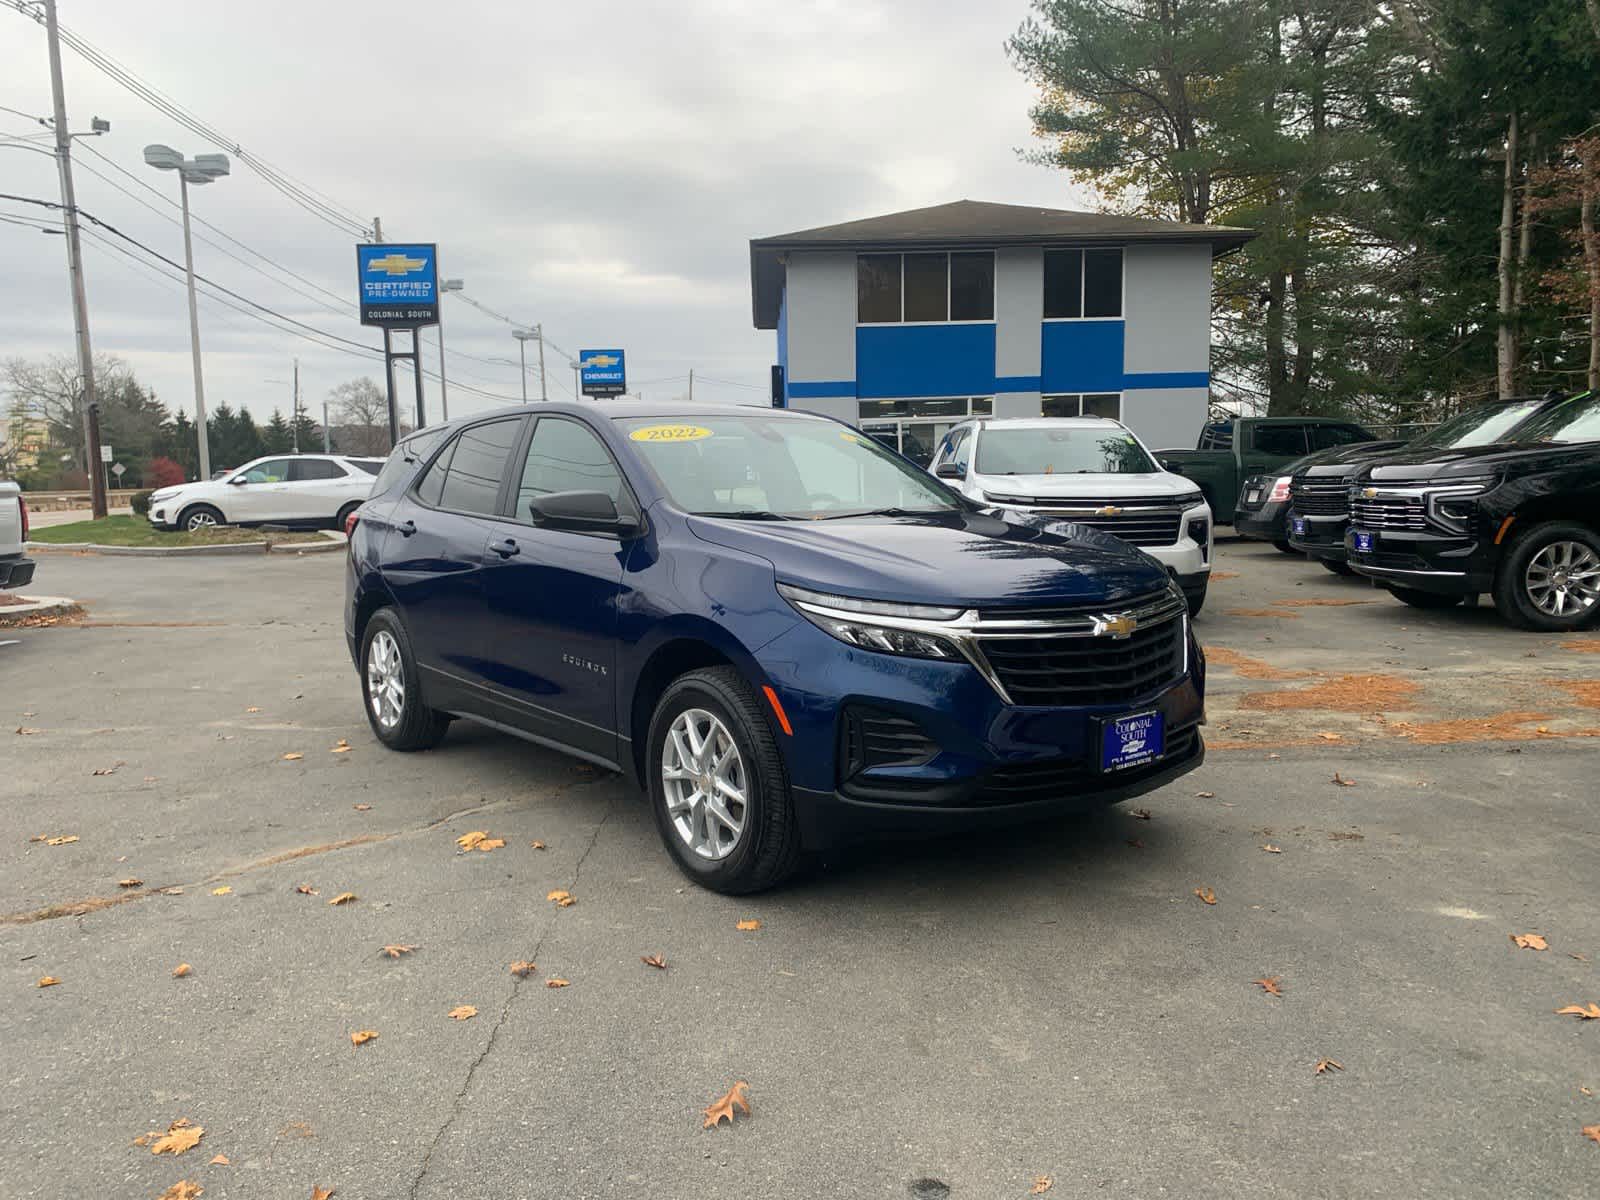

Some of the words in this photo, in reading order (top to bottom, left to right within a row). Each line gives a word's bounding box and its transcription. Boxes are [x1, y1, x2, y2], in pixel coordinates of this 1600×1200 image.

[407, 310, 432, 318] SOUTH
[647, 427, 699, 439] 2022
[1121, 729, 1146, 743] SOUTH
